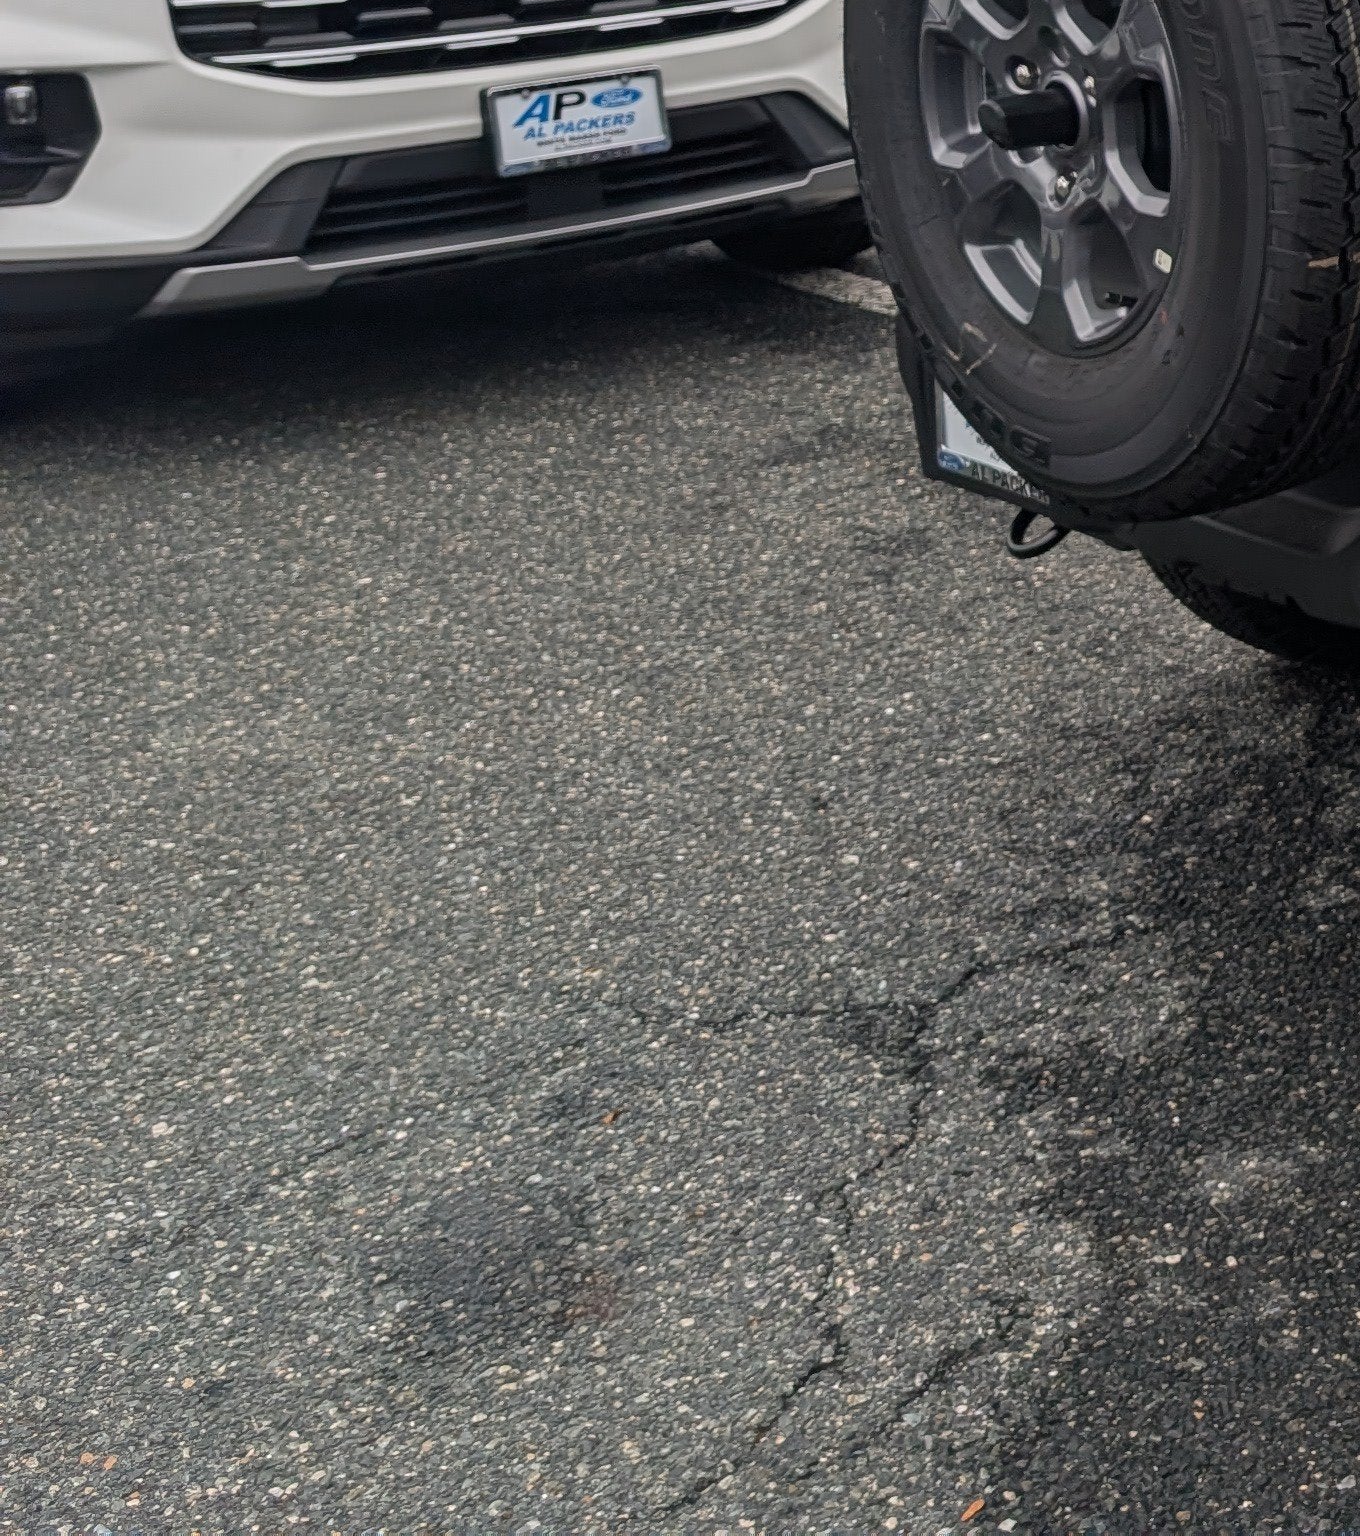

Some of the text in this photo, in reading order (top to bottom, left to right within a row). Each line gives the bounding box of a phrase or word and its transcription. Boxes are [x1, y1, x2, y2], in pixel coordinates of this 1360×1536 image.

[512, 91, 587, 128] AP
[523, 125, 547, 141] AL
[553, 111, 636, 135] PACKERS
